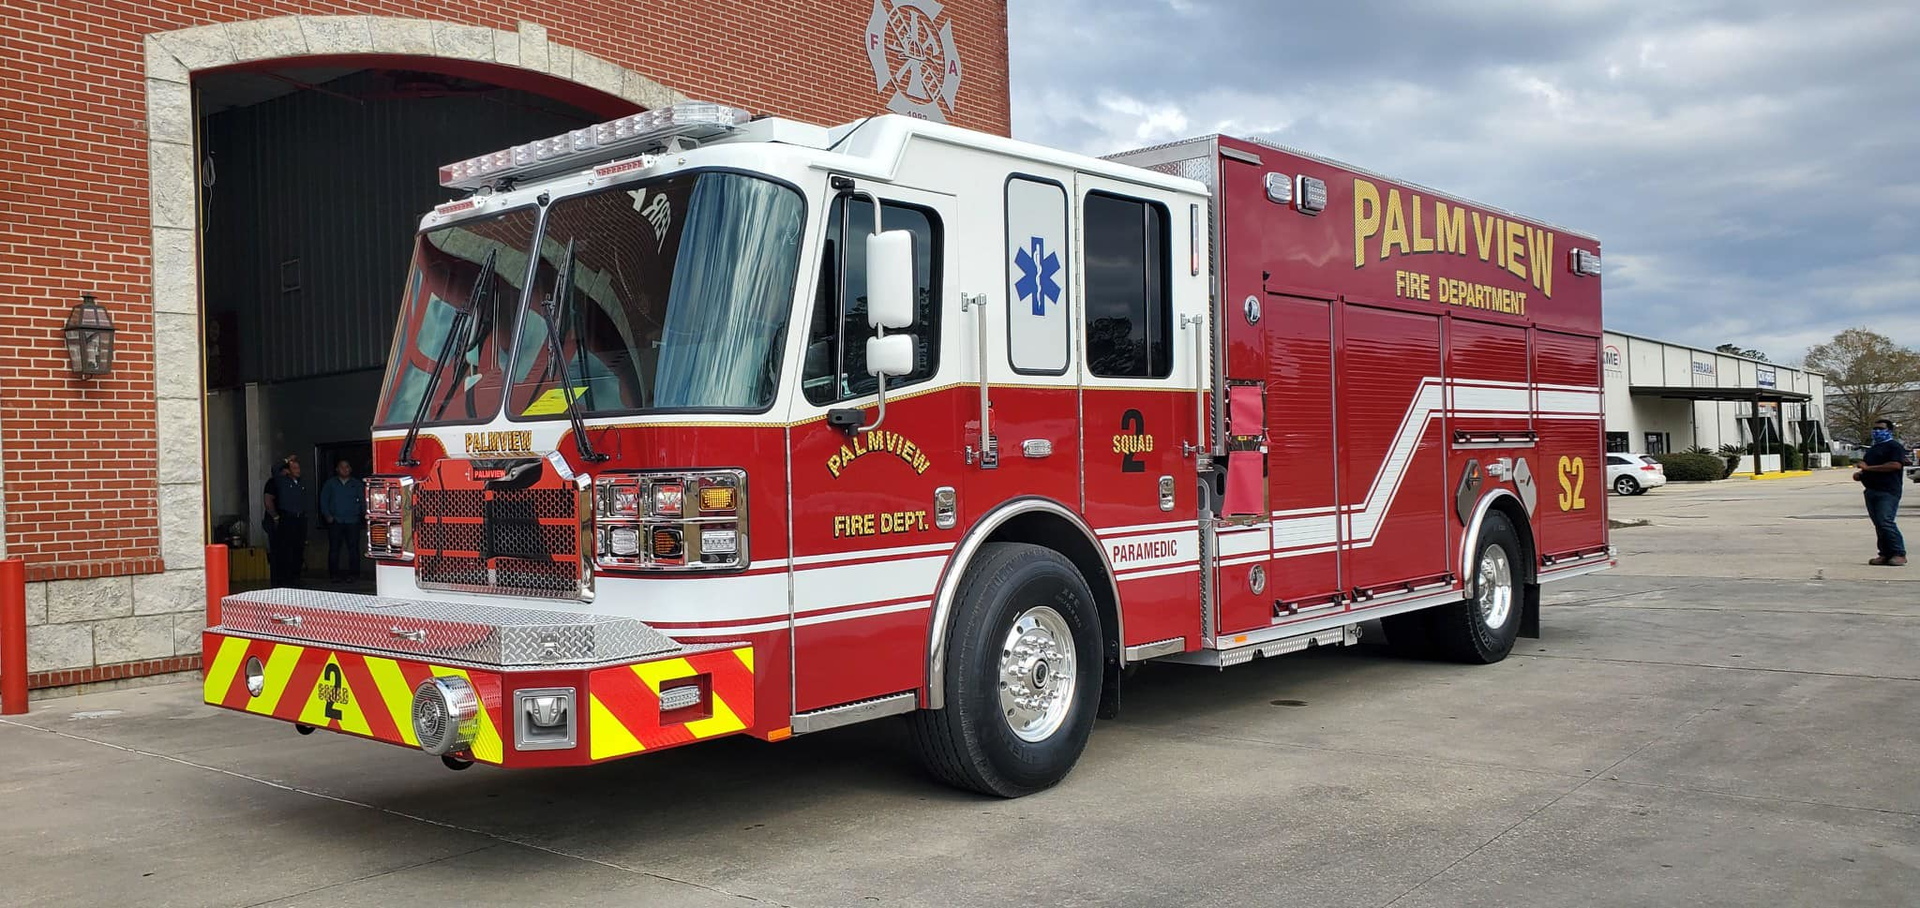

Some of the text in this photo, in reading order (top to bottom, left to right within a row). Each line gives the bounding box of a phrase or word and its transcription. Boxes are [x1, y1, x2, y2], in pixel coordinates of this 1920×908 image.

[870, 33, 879, 50] F
[948, 60, 958, 77] A
[1396, 269, 1527, 315] FIRE DEPARTMENT
[465, 430, 532, 453] PALMVIEW
[1113, 433, 1153, 455] SQUAD
[1121, 408, 1145, 473] 2
[827, 430, 931, 479] PALMVIEW
[474, 469, 506, 479] PALMVIEW
[1558, 455, 1586, 512] S2
[834, 510, 929, 538] FIRE DEPT.
[1113, 539, 1178, 563] PARAMEDIC
[325, 663, 342, 720] 2
